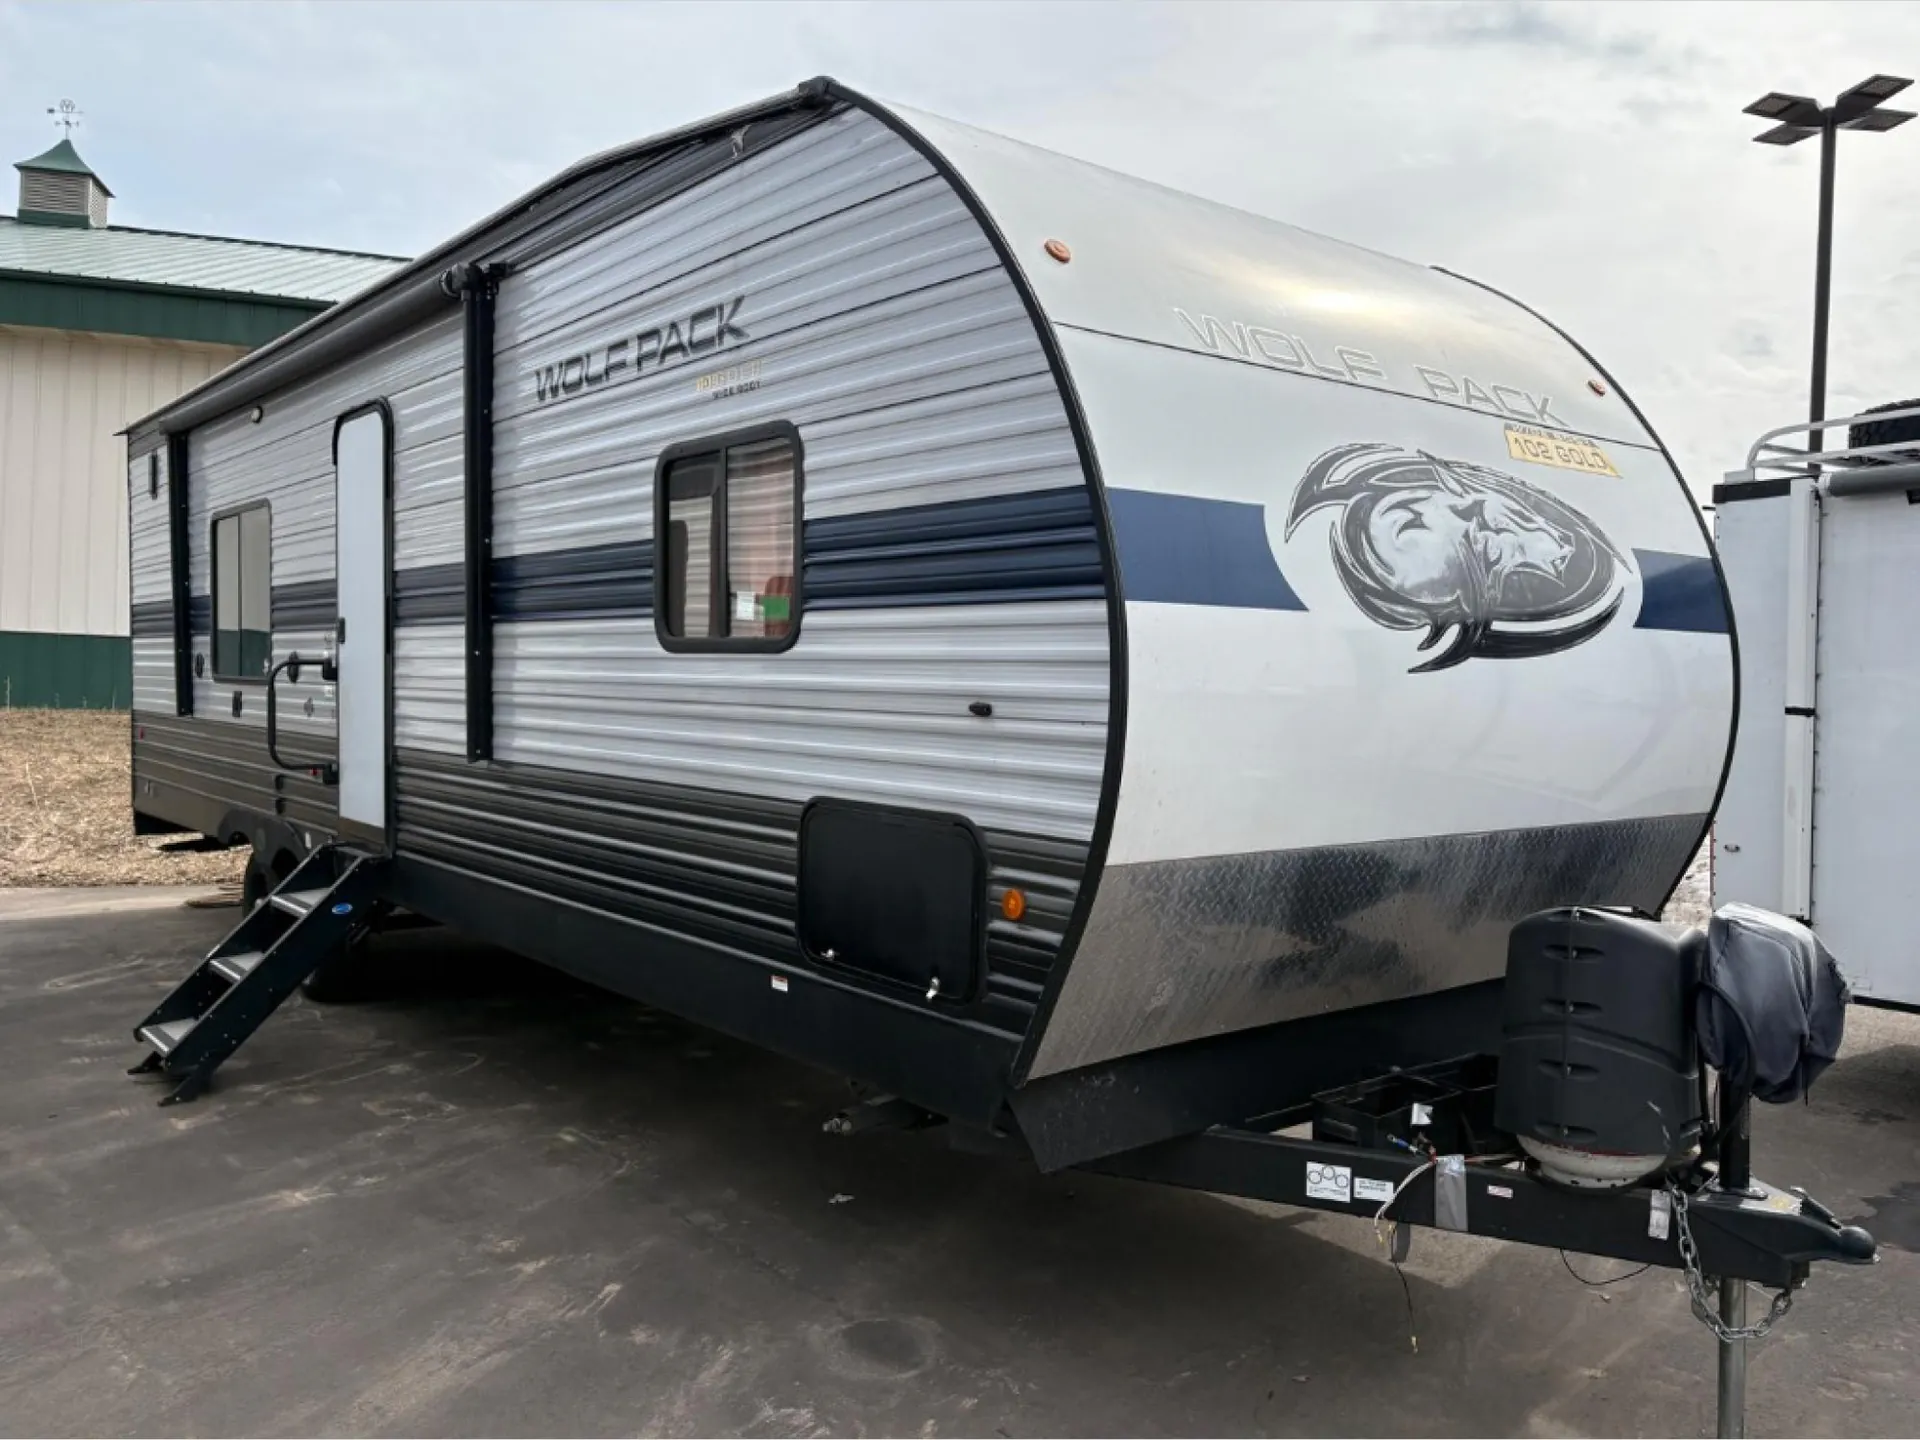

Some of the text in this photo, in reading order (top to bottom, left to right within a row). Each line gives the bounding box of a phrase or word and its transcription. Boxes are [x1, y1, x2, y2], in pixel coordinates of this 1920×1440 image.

[534, 340, 629, 401] WOLF
[636, 295, 750, 371] PACK
[1173, 307, 1571, 427] WOLF PACK
[1514, 437, 1608, 470] 102 GOLD
